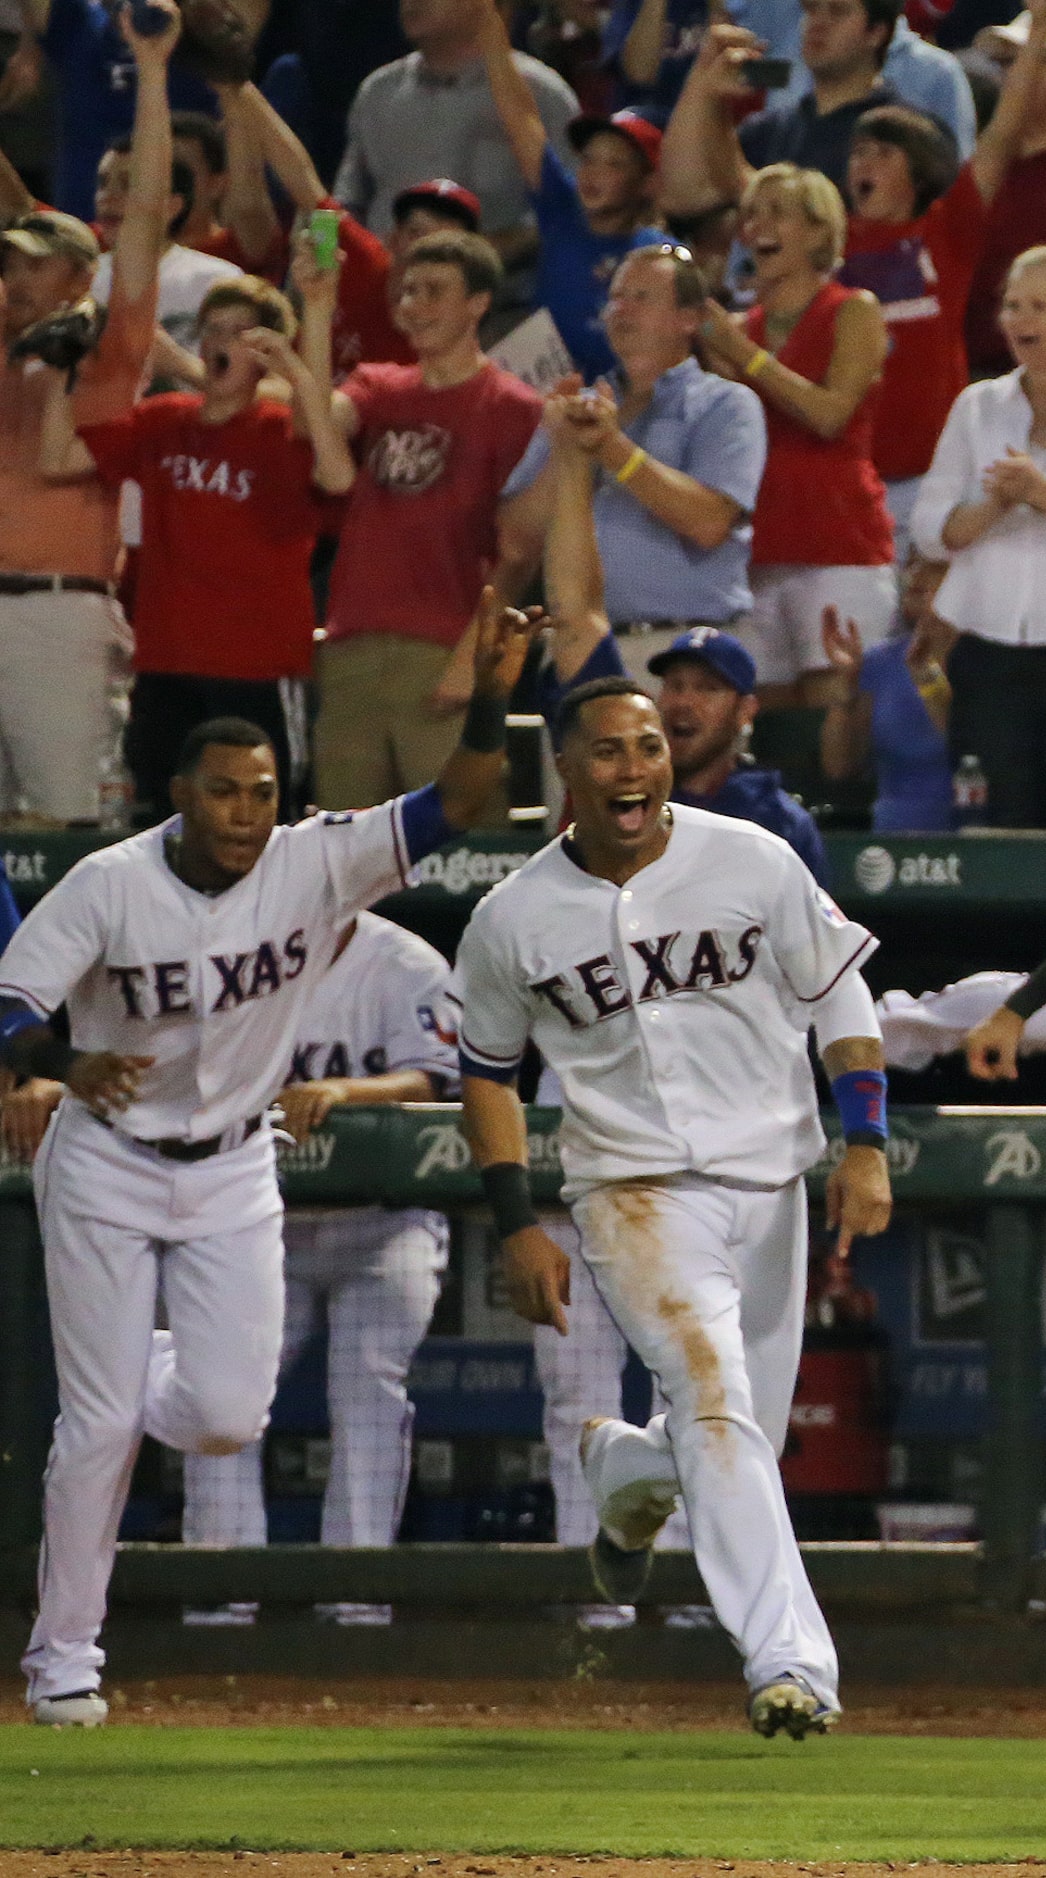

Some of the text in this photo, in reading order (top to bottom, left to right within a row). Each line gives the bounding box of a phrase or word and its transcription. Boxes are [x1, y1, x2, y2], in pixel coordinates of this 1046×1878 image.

[900, 853, 961, 885] at&t
[106, 928, 308, 1019] TEXAS
[530, 925, 764, 1030] TEXAS
[284, 1043, 386, 1086] XAS
